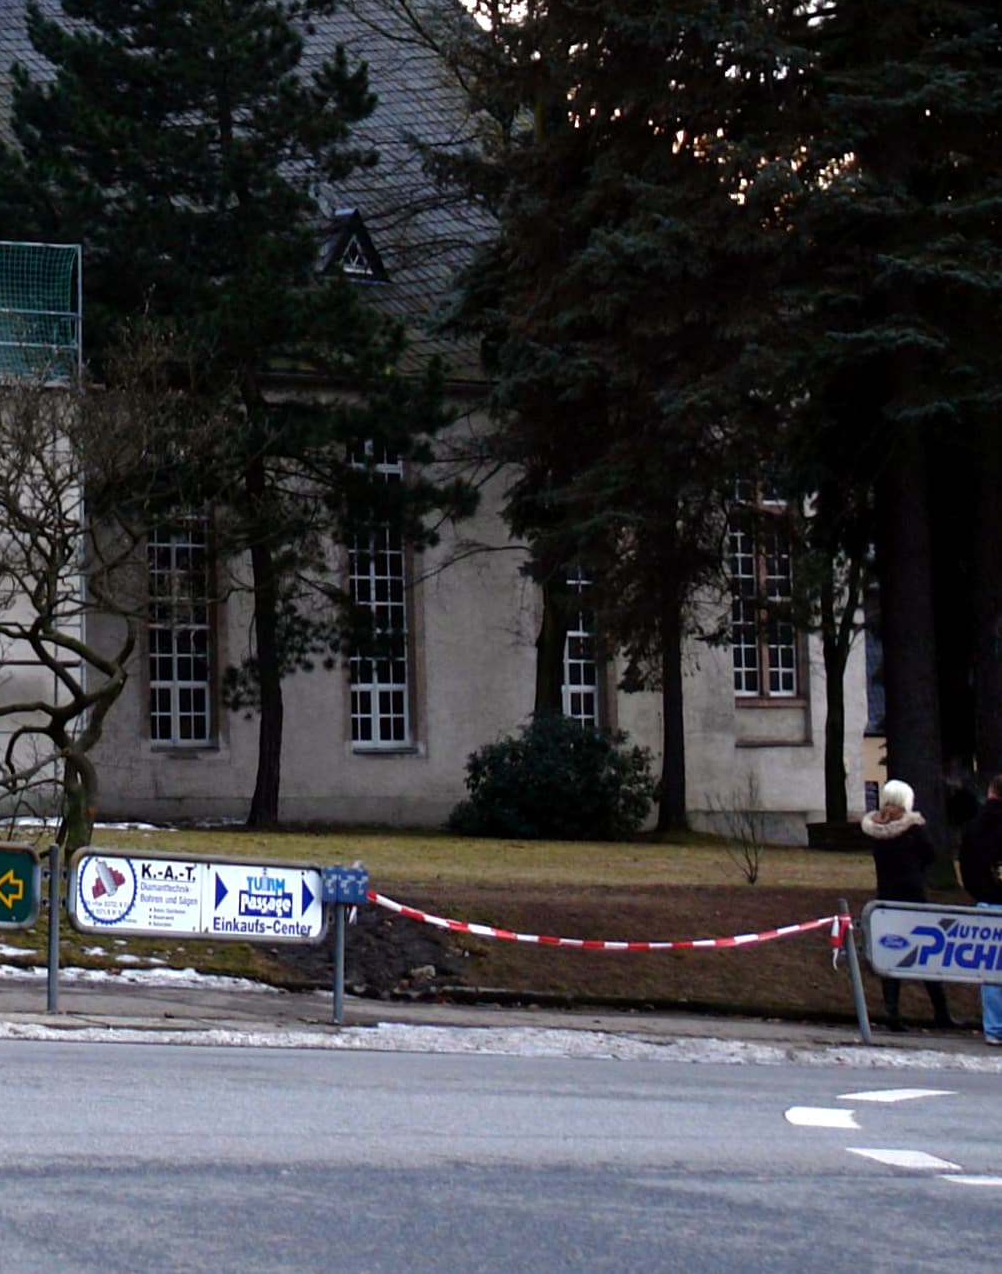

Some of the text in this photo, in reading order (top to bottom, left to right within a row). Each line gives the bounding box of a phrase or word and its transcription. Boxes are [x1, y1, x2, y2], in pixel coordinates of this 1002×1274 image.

[141, 863, 196, 881] K.-A.-T.
[165, 894, 177, 904] und
[240, 892, 292, 917] Passage
[213, 916, 313, 936] Einkaufs-Center
